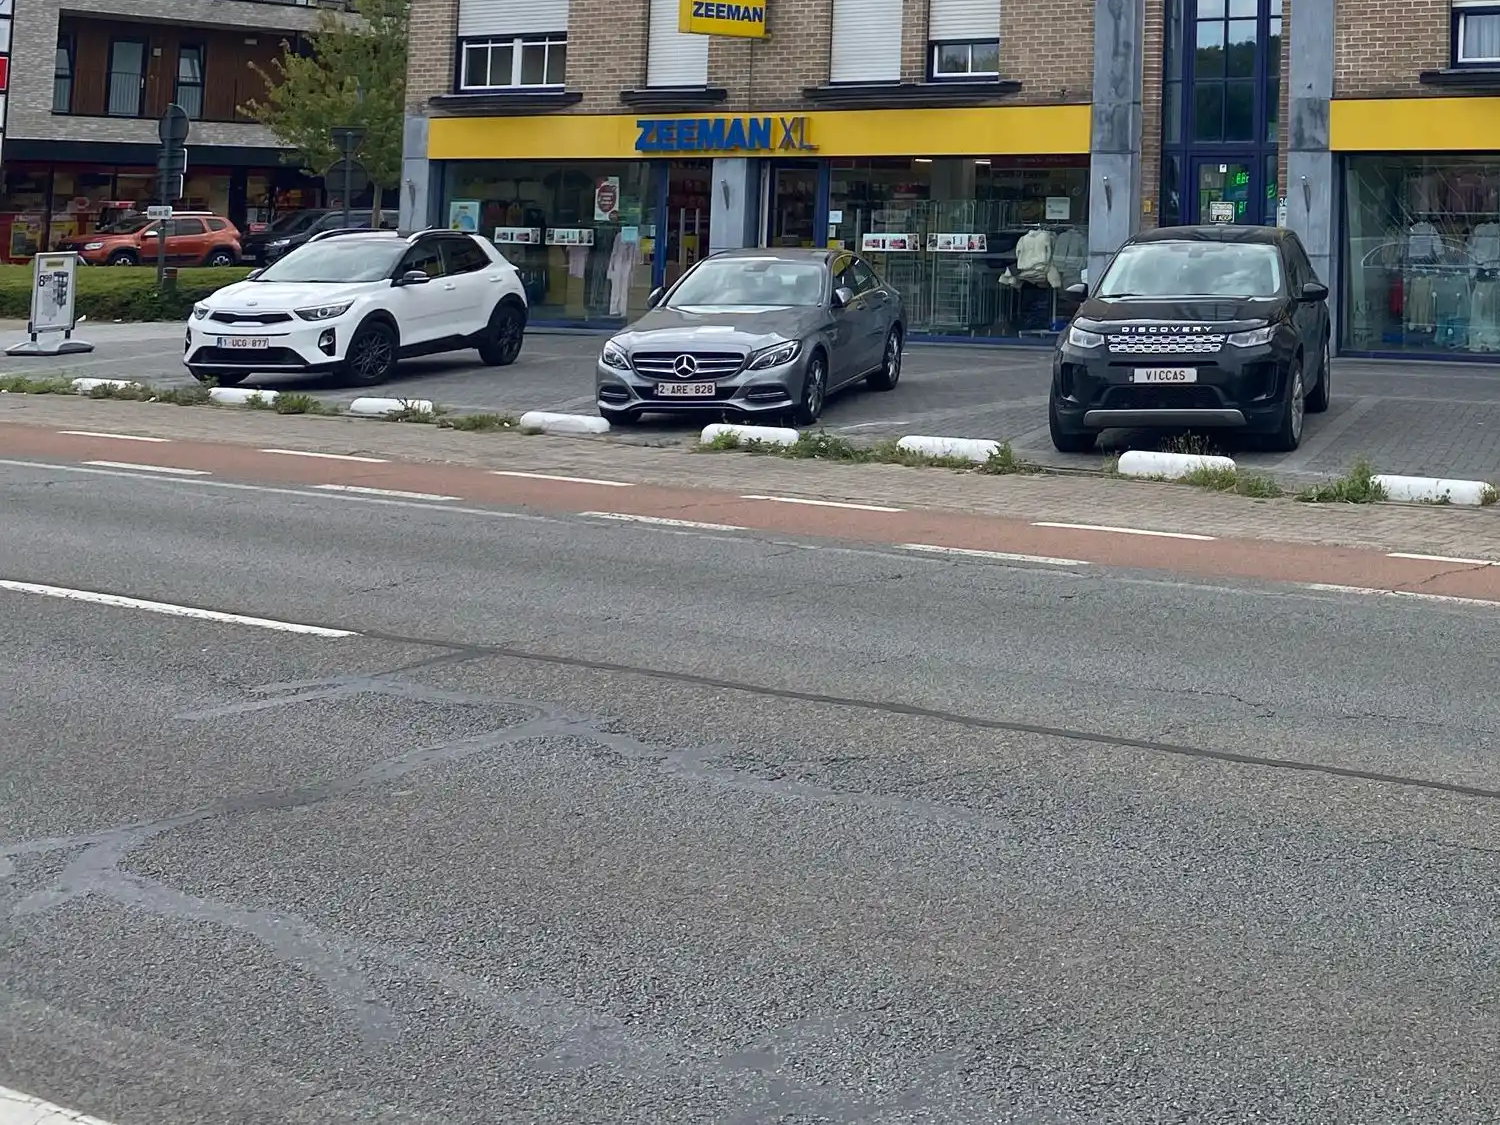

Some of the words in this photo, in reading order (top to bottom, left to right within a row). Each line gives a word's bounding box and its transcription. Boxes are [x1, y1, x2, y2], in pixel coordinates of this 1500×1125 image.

[692, 1, 764, 23] ZEEMAN
[635, 118, 772, 151] ZEEMAN
[778, 117, 820, 151] XL
[1145, 370, 1186, 381] VICCAS
